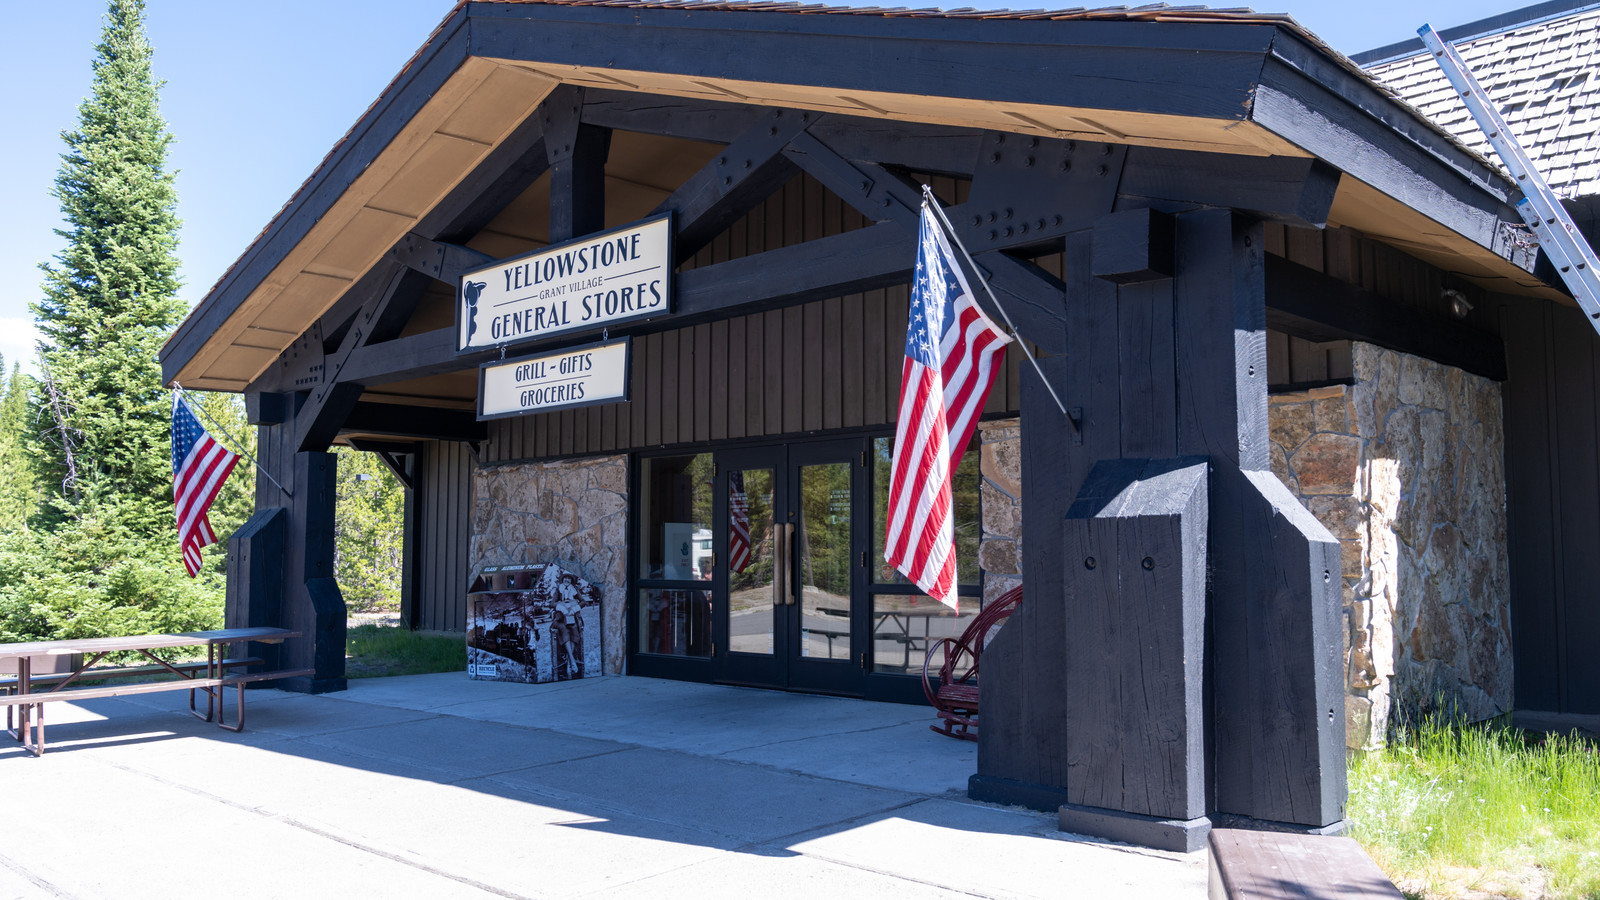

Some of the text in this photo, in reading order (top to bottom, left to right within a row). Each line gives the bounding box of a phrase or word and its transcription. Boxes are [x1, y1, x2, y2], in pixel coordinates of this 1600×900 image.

[504, 234, 641, 292] YELLOWSTONE
[540, 276, 603, 300] GRANT VILLAGE
[491, 280, 661, 339] GENERAL STORES
[515, 361, 546, 382] GRILL
[559, 353, 592, 374] GIFTS
[520, 382, 585, 407] GROCERIES
